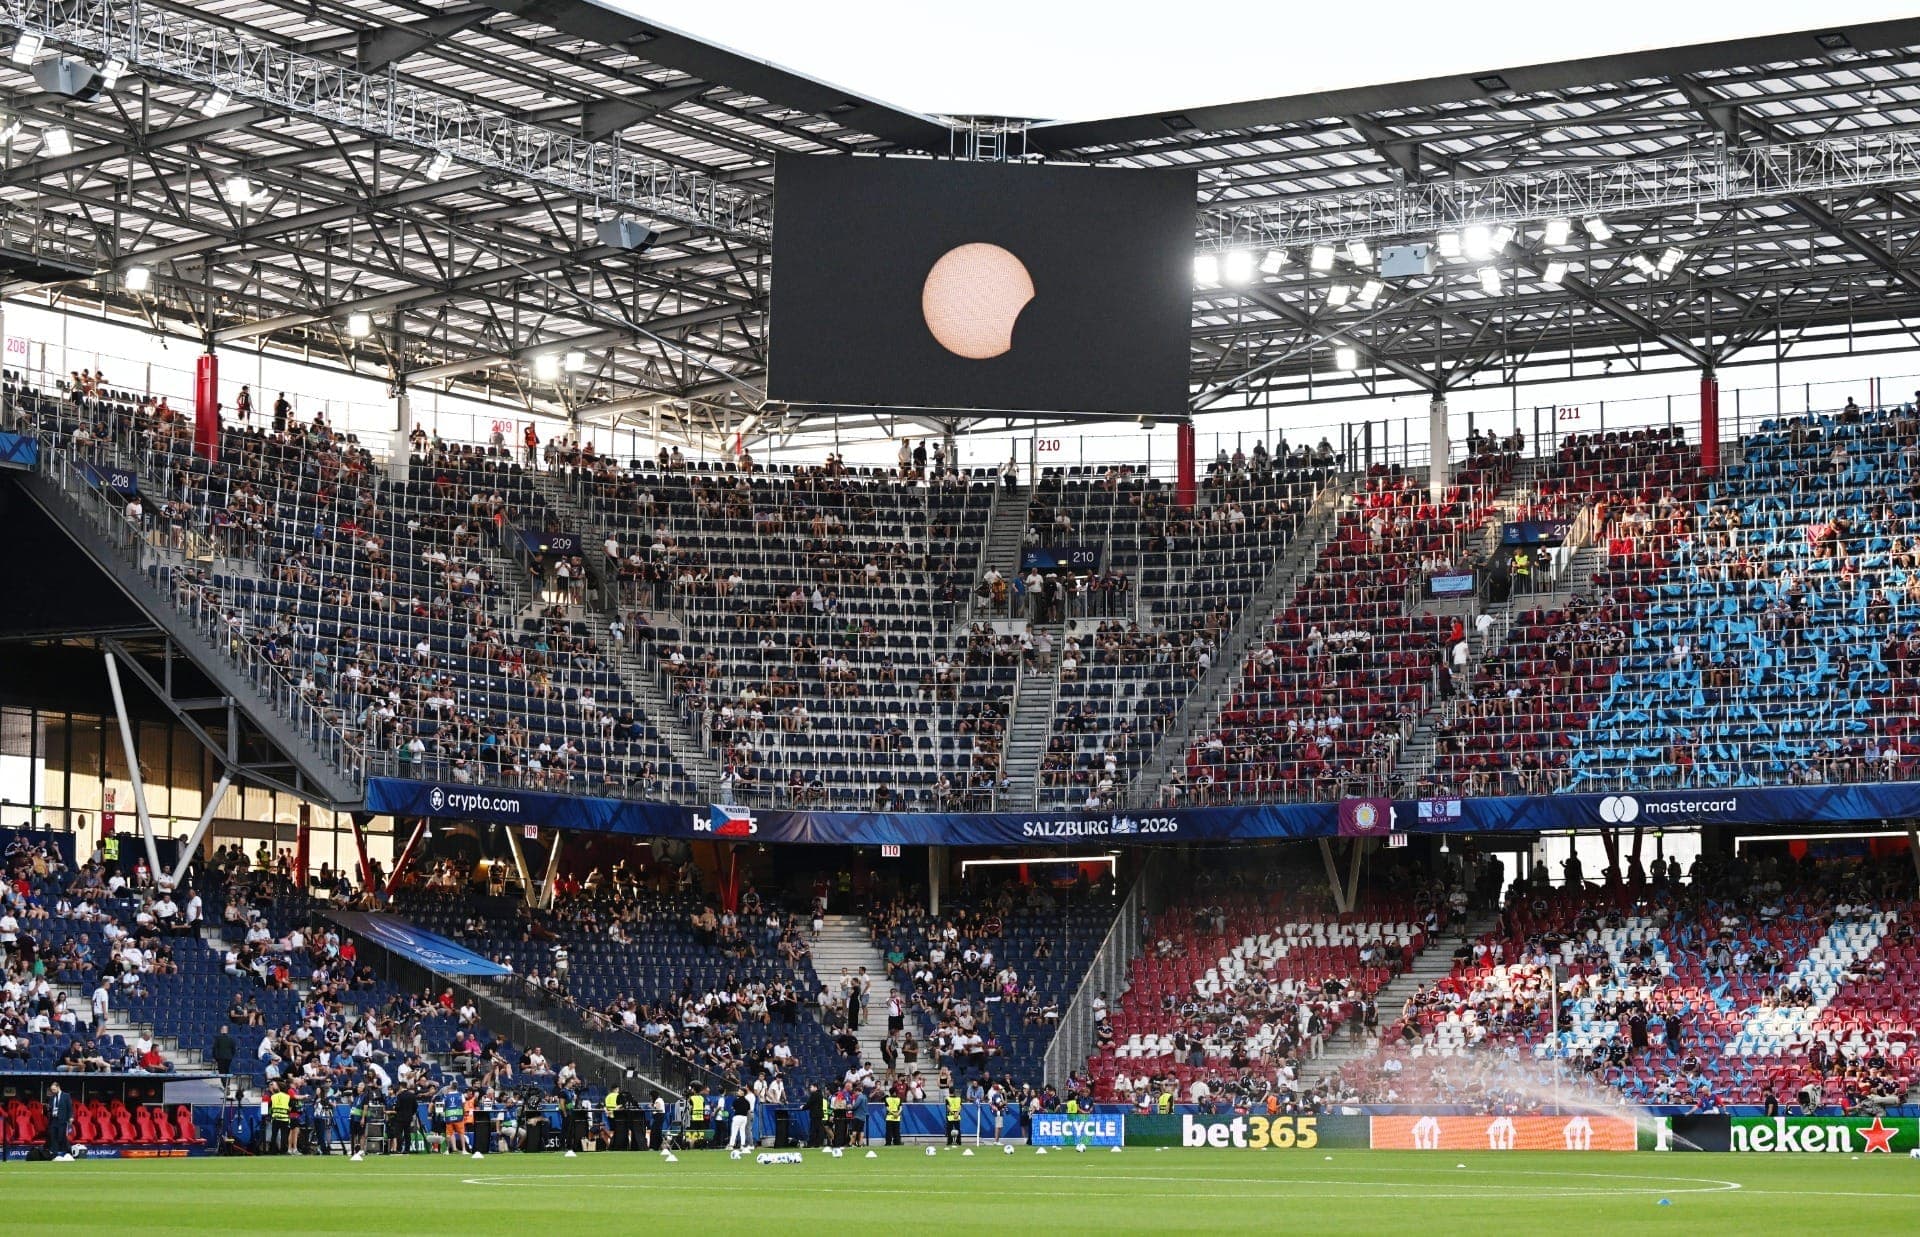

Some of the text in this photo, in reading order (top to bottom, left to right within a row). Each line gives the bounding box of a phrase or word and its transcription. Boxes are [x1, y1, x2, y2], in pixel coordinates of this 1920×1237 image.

[7, 338, 26, 354] 208
[1559, 407, 1581, 420] 211
[491, 419, 513, 433] 209
[1038, 439, 1060, 451] 210
[111, 473, 129, 488] 208
[551, 537, 572, 550] 209
[1073, 551, 1094, 563] 210
[447, 793, 520, 813] crypto.com
[1645, 798, 1737, 814] mastercard
[526, 825, 537, 838] 109
[693, 814, 758, 834] be5
[1023, 817, 1178, 837] SALZBURG 2026
[884, 845, 899, 856] 110
[1039, 1121, 1116, 1137] RECYCLE
[1183, 1113, 1318, 1150] bet365
